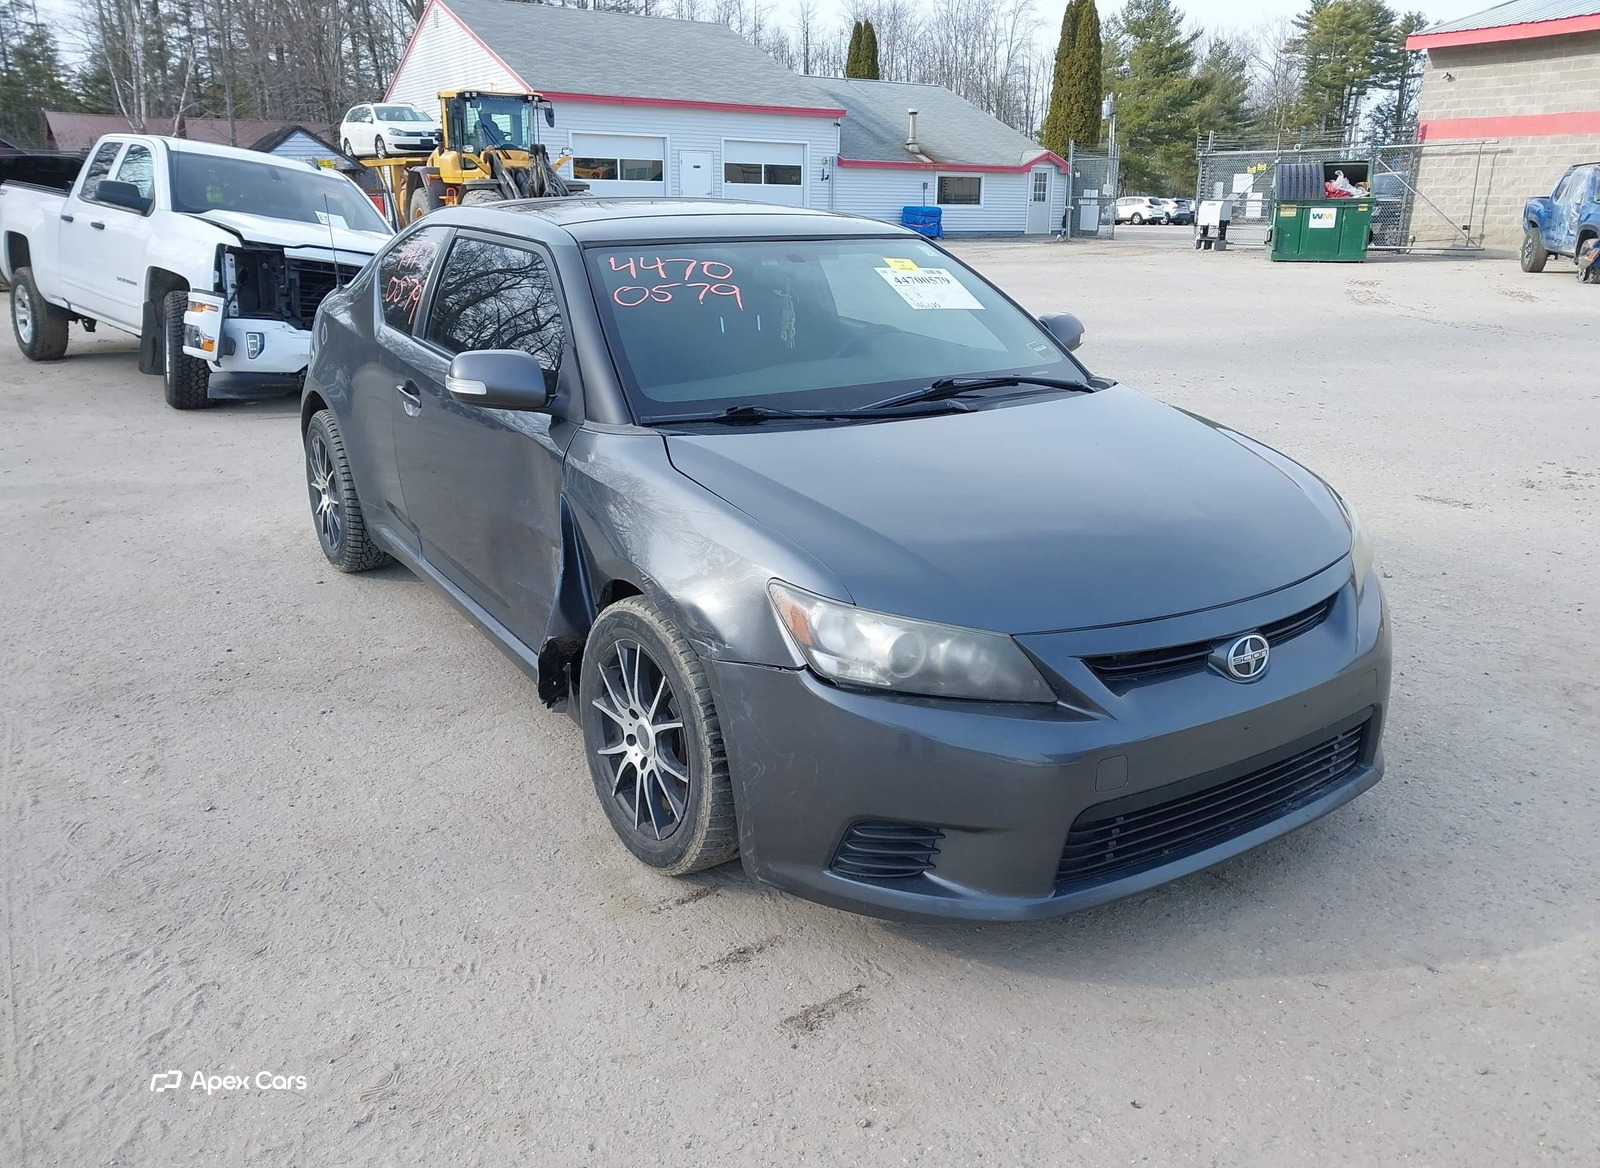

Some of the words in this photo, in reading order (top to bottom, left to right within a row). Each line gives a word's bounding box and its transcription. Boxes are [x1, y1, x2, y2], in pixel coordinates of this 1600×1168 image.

[608, 256, 734, 281] 4470
[894, 276, 951, 285] 44700579
[613, 282, 744, 311] 0579
[1233, 649, 1268, 664] SCION
